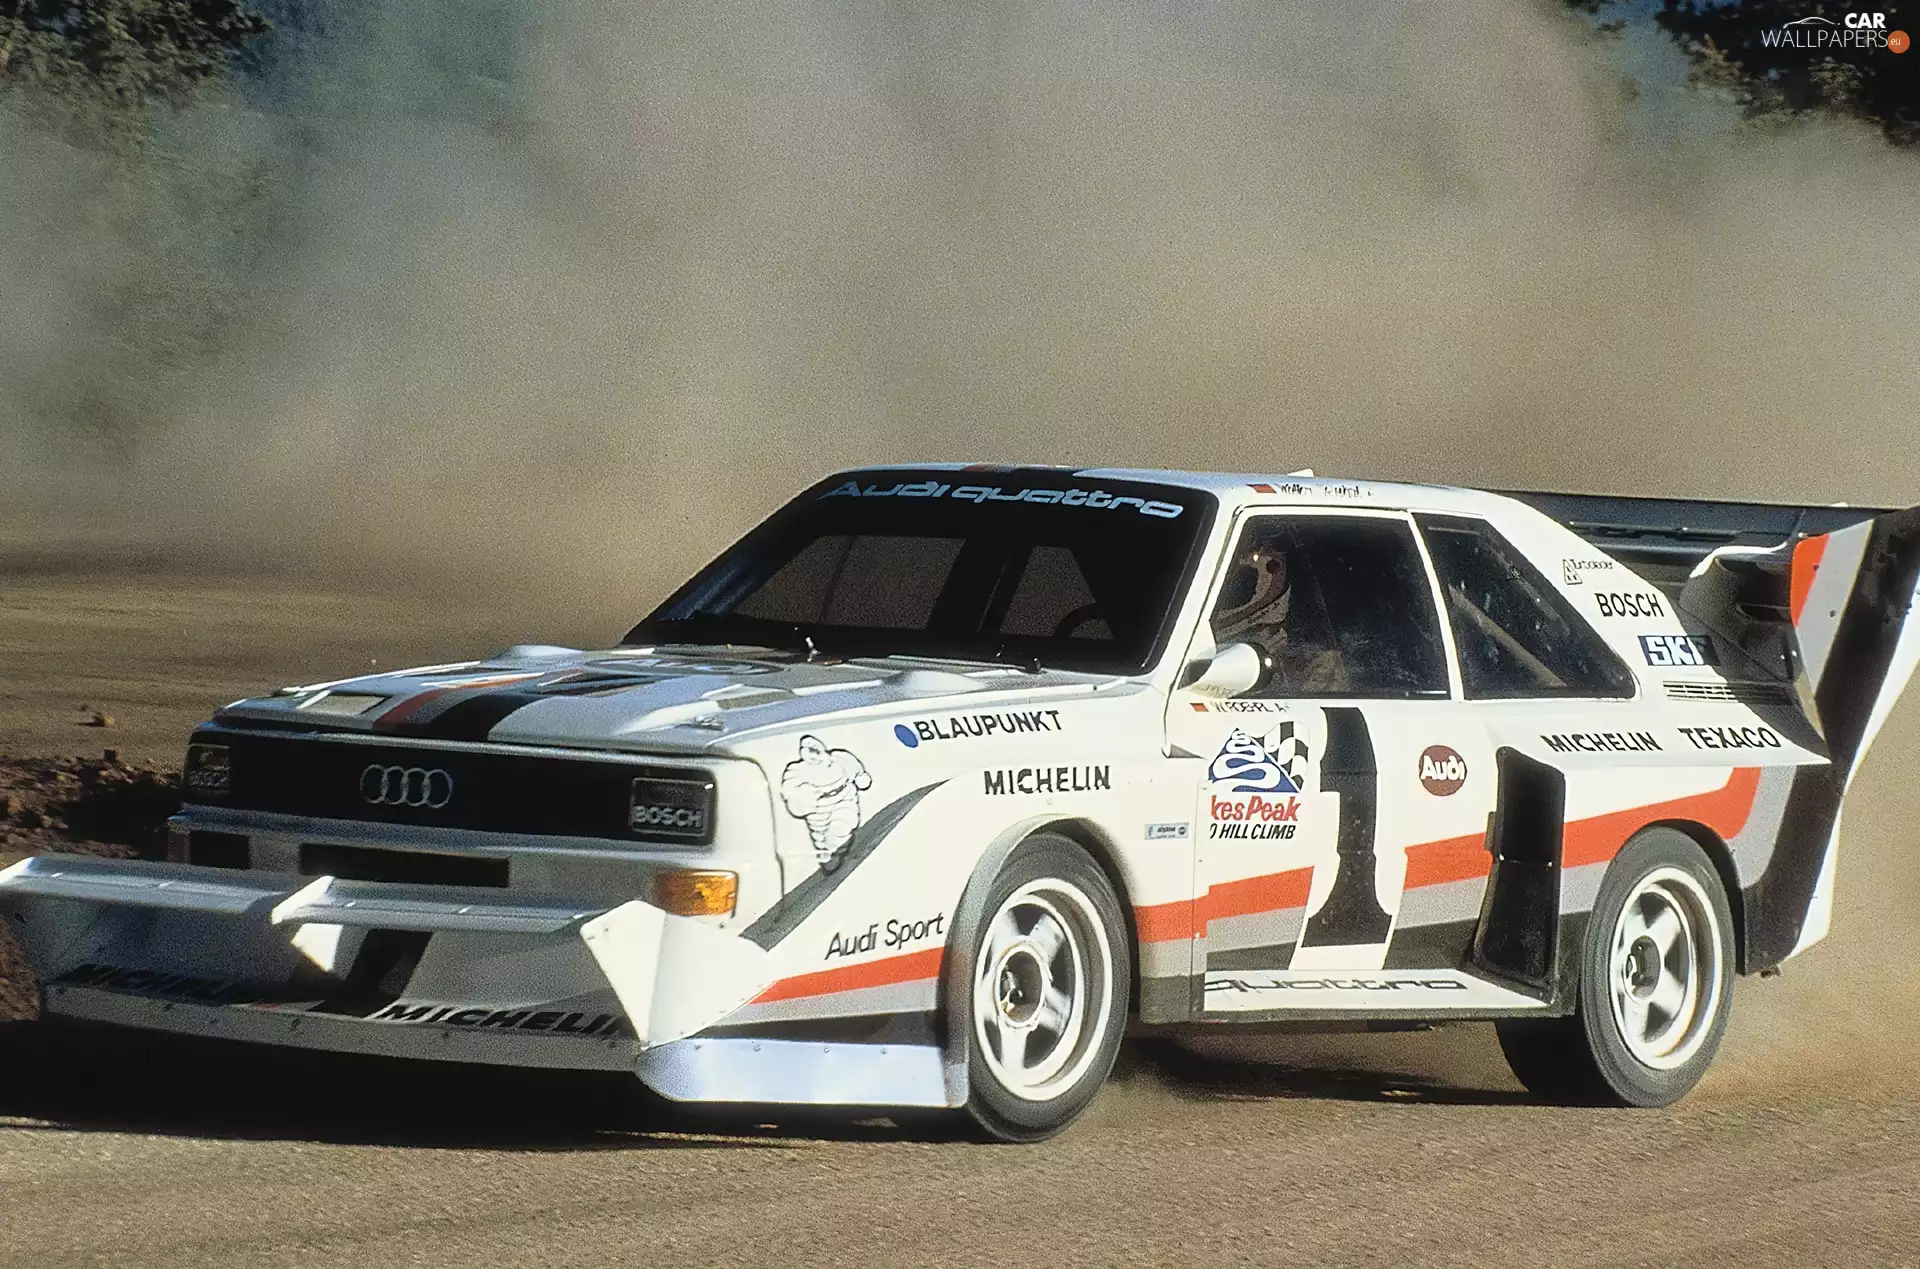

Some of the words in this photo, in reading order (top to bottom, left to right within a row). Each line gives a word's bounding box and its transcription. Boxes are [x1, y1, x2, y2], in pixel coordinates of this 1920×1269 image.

[815, 480, 950, 500] Audi
[951, 485, 1184, 519] quattro
[1594, 592, 1665, 617] BOSCH
[913, 710, 1063, 741] BLAUPUNKT
[1540, 731, 1663, 752] MICHELIN
[1677, 727, 1781, 749] TEXACO
[984, 765, 1111, 796] MICHELIN
[1420, 755, 1465, 780] Audi
[633, 804, 702, 828] BOSCH
[1245, 795, 1302, 822] Peak
[1219, 823, 1249, 839] HILL
[1250, 823, 1297, 840] CLIMB
[1301, 706, 1393, 948] 1
[825, 923, 880, 961] Audi
[884, 913, 944, 948] Sport
